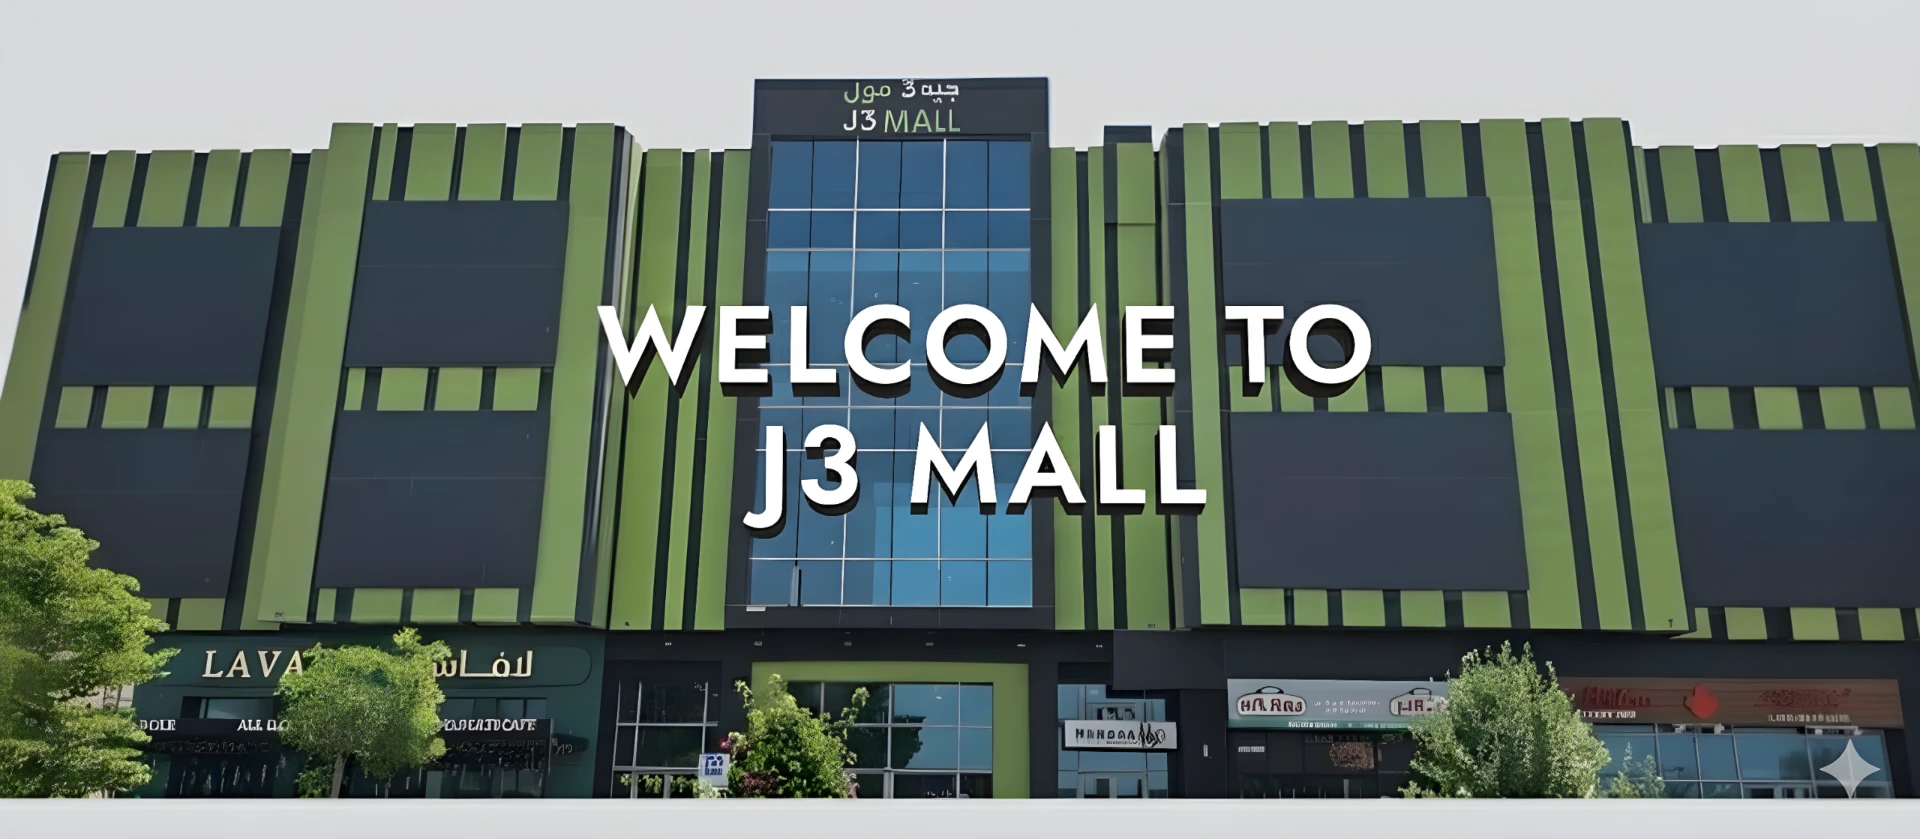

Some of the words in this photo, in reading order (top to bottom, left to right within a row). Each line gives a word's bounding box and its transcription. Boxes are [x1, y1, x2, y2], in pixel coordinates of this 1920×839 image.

[844, 82, 891, 104] مول
[843, 110, 877, 131] J3
[884, 109, 961, 132] MALL
